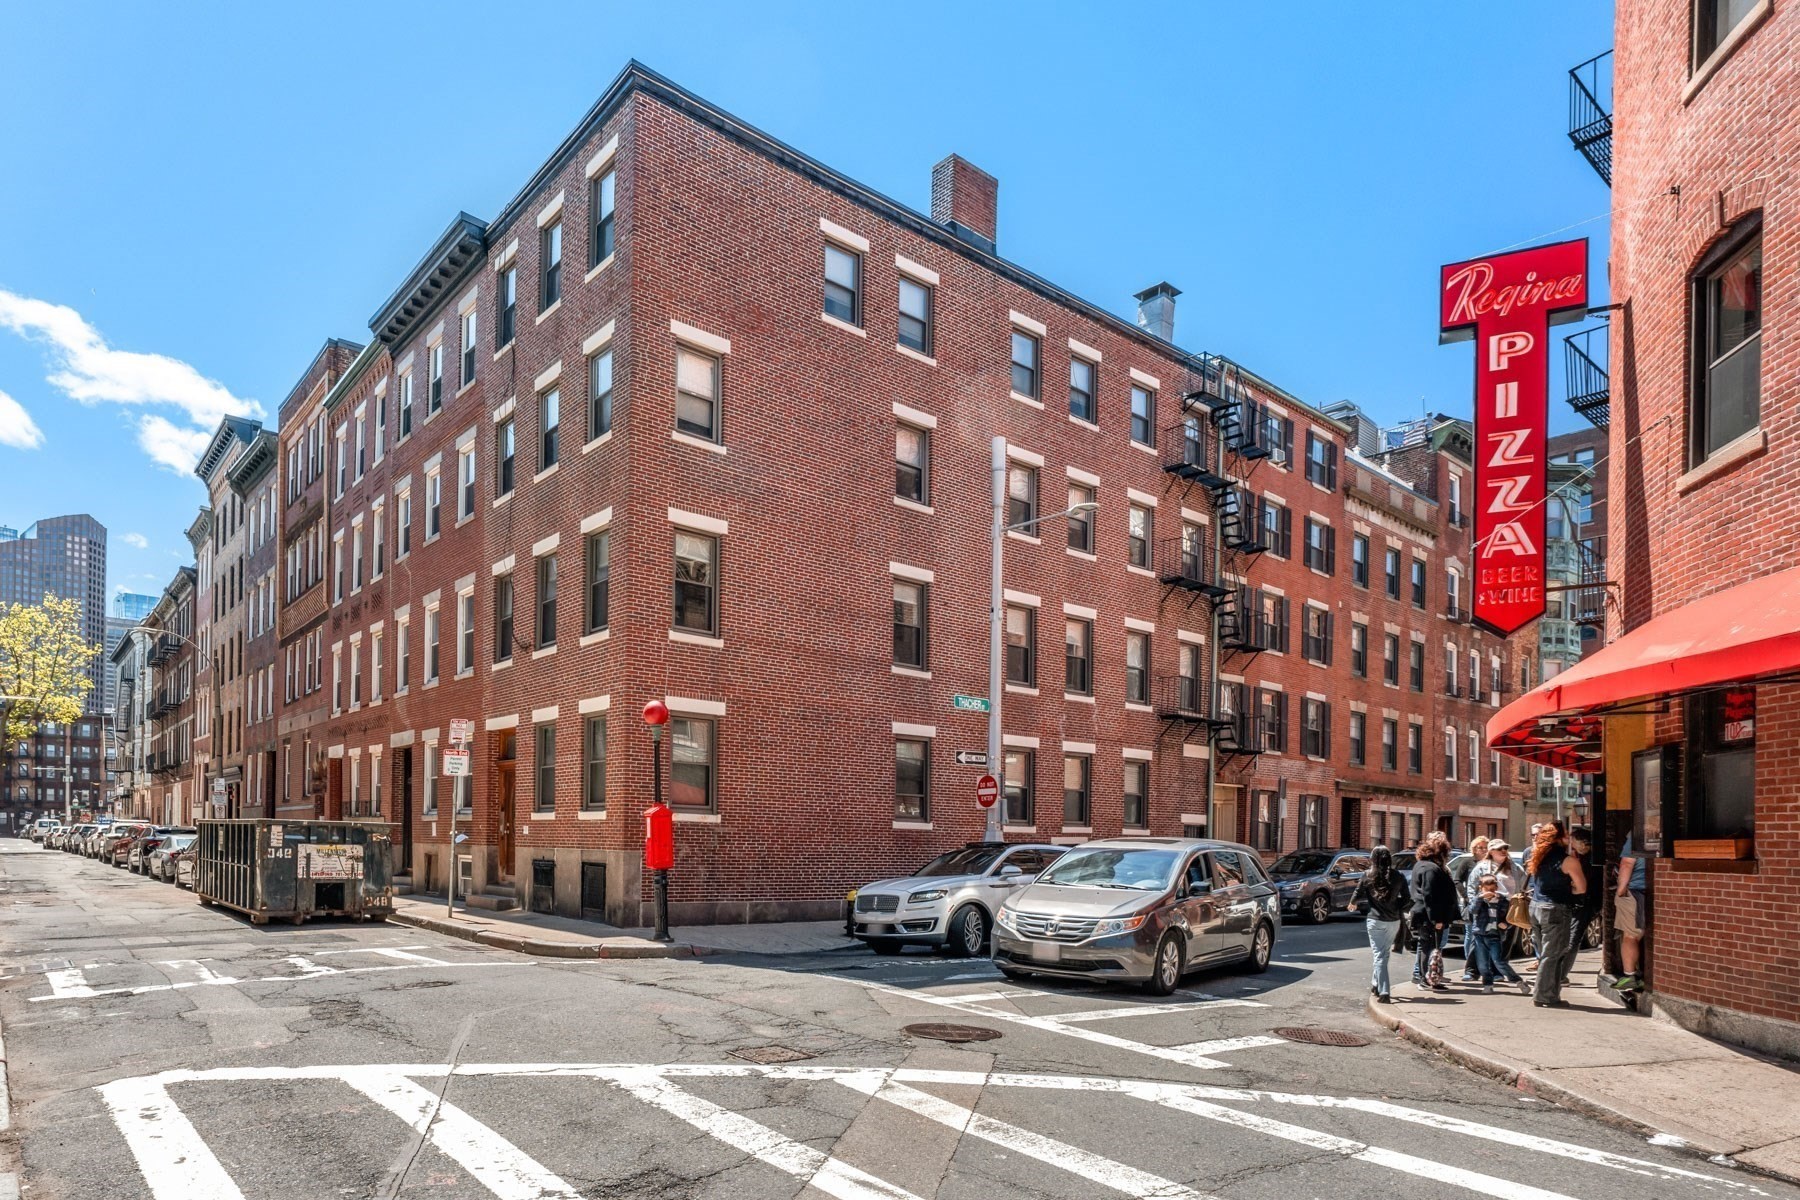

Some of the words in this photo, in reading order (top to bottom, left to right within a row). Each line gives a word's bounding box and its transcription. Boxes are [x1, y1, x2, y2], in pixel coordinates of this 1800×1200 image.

[1446, 262, 1582, 322] Regina
[1481, 331, 1538, 559] PIZZA
[1482, 565, 1538, 585] BEER
[1487, 587, 1540, 605] WINE
[958, 697, 982, 710] THACHER
